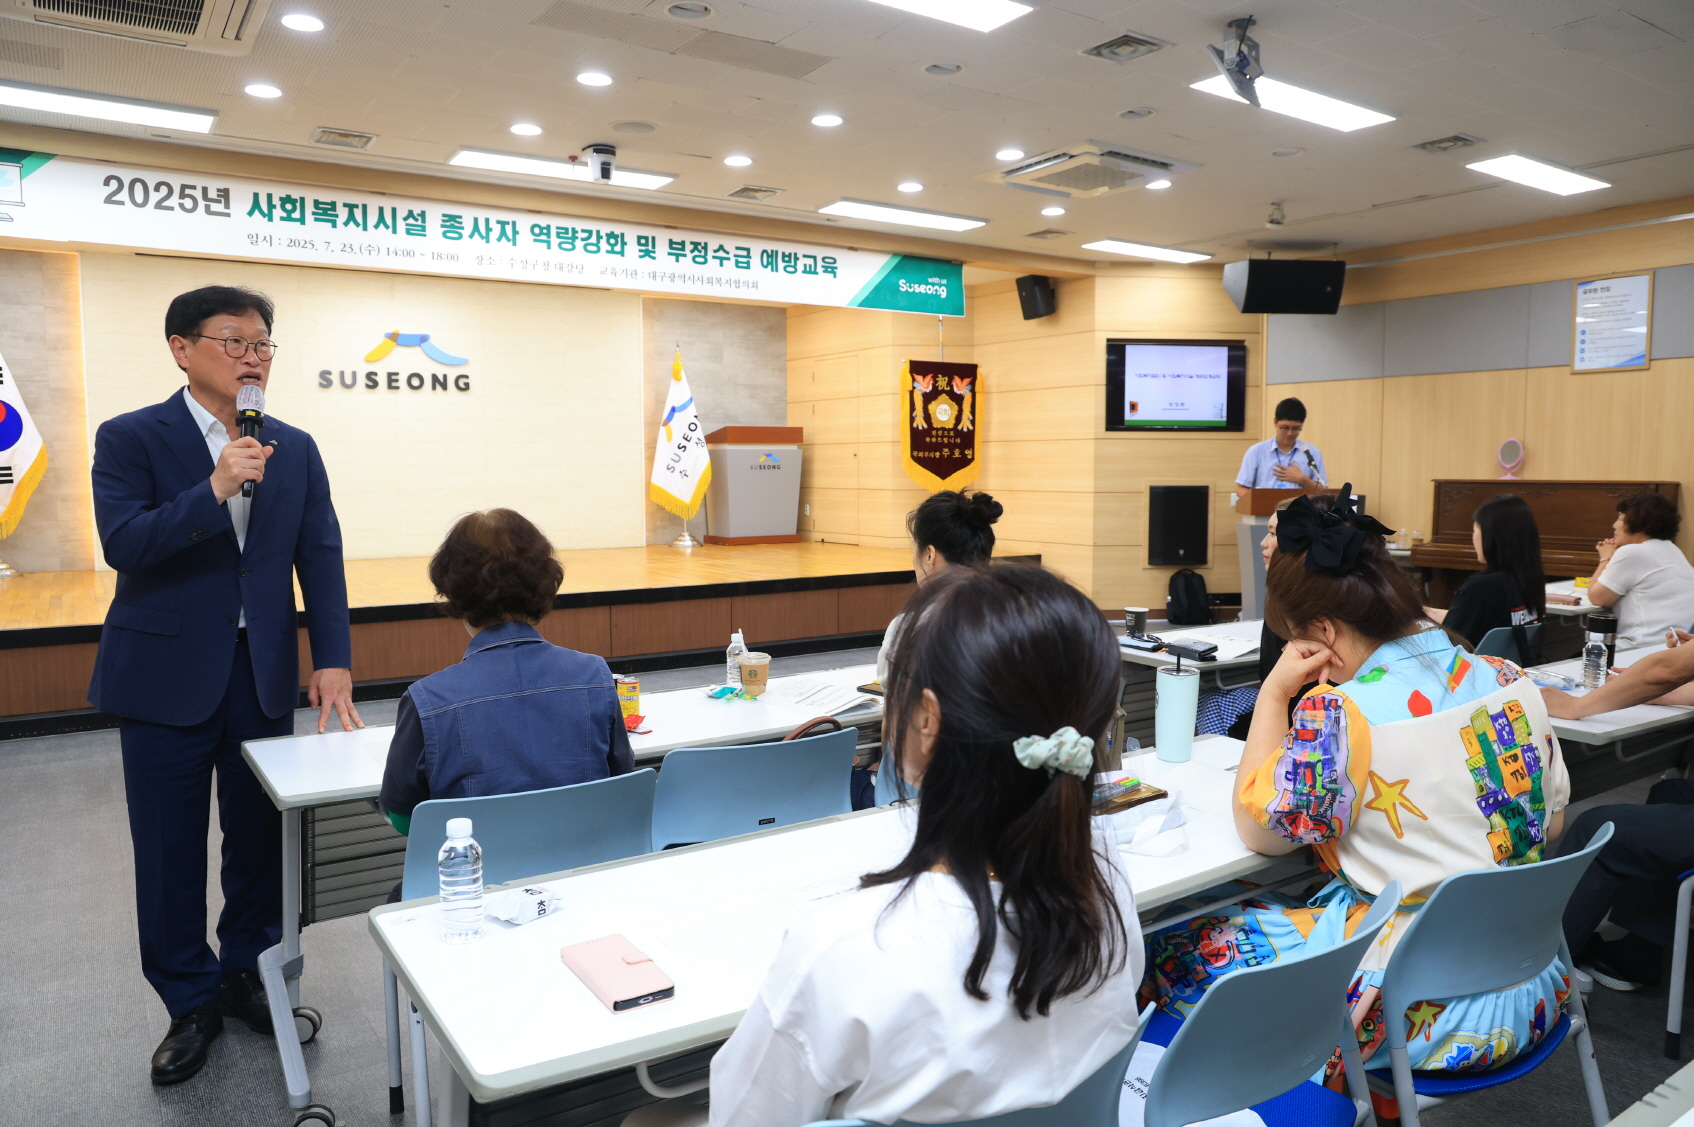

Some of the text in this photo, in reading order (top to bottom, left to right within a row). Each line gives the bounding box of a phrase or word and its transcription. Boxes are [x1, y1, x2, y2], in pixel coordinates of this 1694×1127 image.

[102, 174, 838, 278] 2025년 사회복지시설 종사자 역량강화 및 부정수급 예방교육
[247, 233, 274, 247] 일시
[286, 237, 318, 251] 2025.
[386, 246, 416, 259] 14:00
[430, 251, 459, 262] 18:00
[474, 254, 496, 267] 장소
[507, 256, 551, 272] 수성구청
[554, 260, 585, 275] 대강당
[599, 265, 639, 281] 교육기관
[648, 270, 759, 291] 대구광역시사회복지협의회
[898, 279, 947, 299] Suseong
[927, 276, 940, 284] with
[318, 369, 470, 391] SUSEONG
